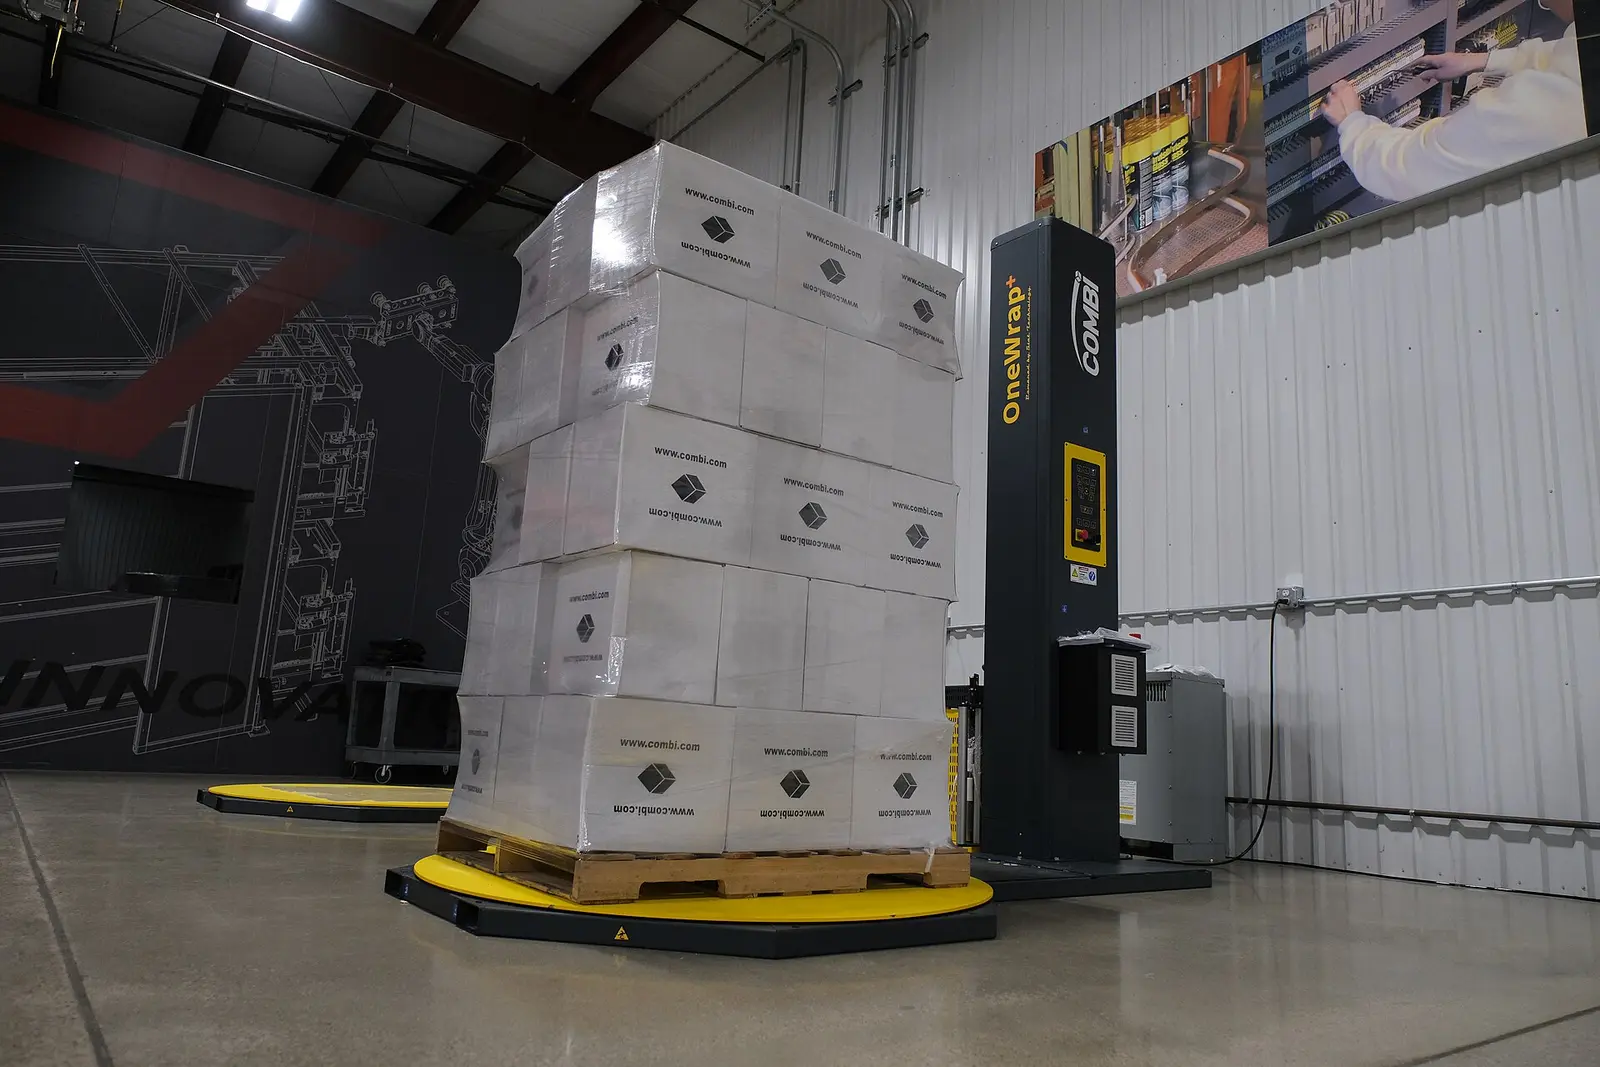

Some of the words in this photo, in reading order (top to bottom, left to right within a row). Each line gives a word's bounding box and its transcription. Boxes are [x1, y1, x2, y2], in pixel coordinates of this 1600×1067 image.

[684, 186, 755, 216] www.combi.com
[680, 241, 751, 270] www.combi.com
[805, 230, 862, 261] www.combi.com
[802, 281, 859, 309] www.combi.com
[901, 272, 947, 301] www.combi.com
[898, 321, 945, 346] www.combi.com
[1082, 275, 1100, 377] COMBI
[654, 446, 728, 470] www.combi.com
[783, 477, 845, 497] www.combi.com
[648, 507, 723, 528] www.combi.com
[892, 500, 944, 518] www.combi.com
[780, 533, 842, 551] www.combi.com
[890, 552, 942, 570] www.combi.com
[620, 738, 701, 752] www.combi.com
[763, 747, 829, 758] www.combi.com
[613, 804, 695, 816] www.combi.com
[759, 809, 825, 818] www.combi.com
[878, 809, 932, 818] www.combi.com
